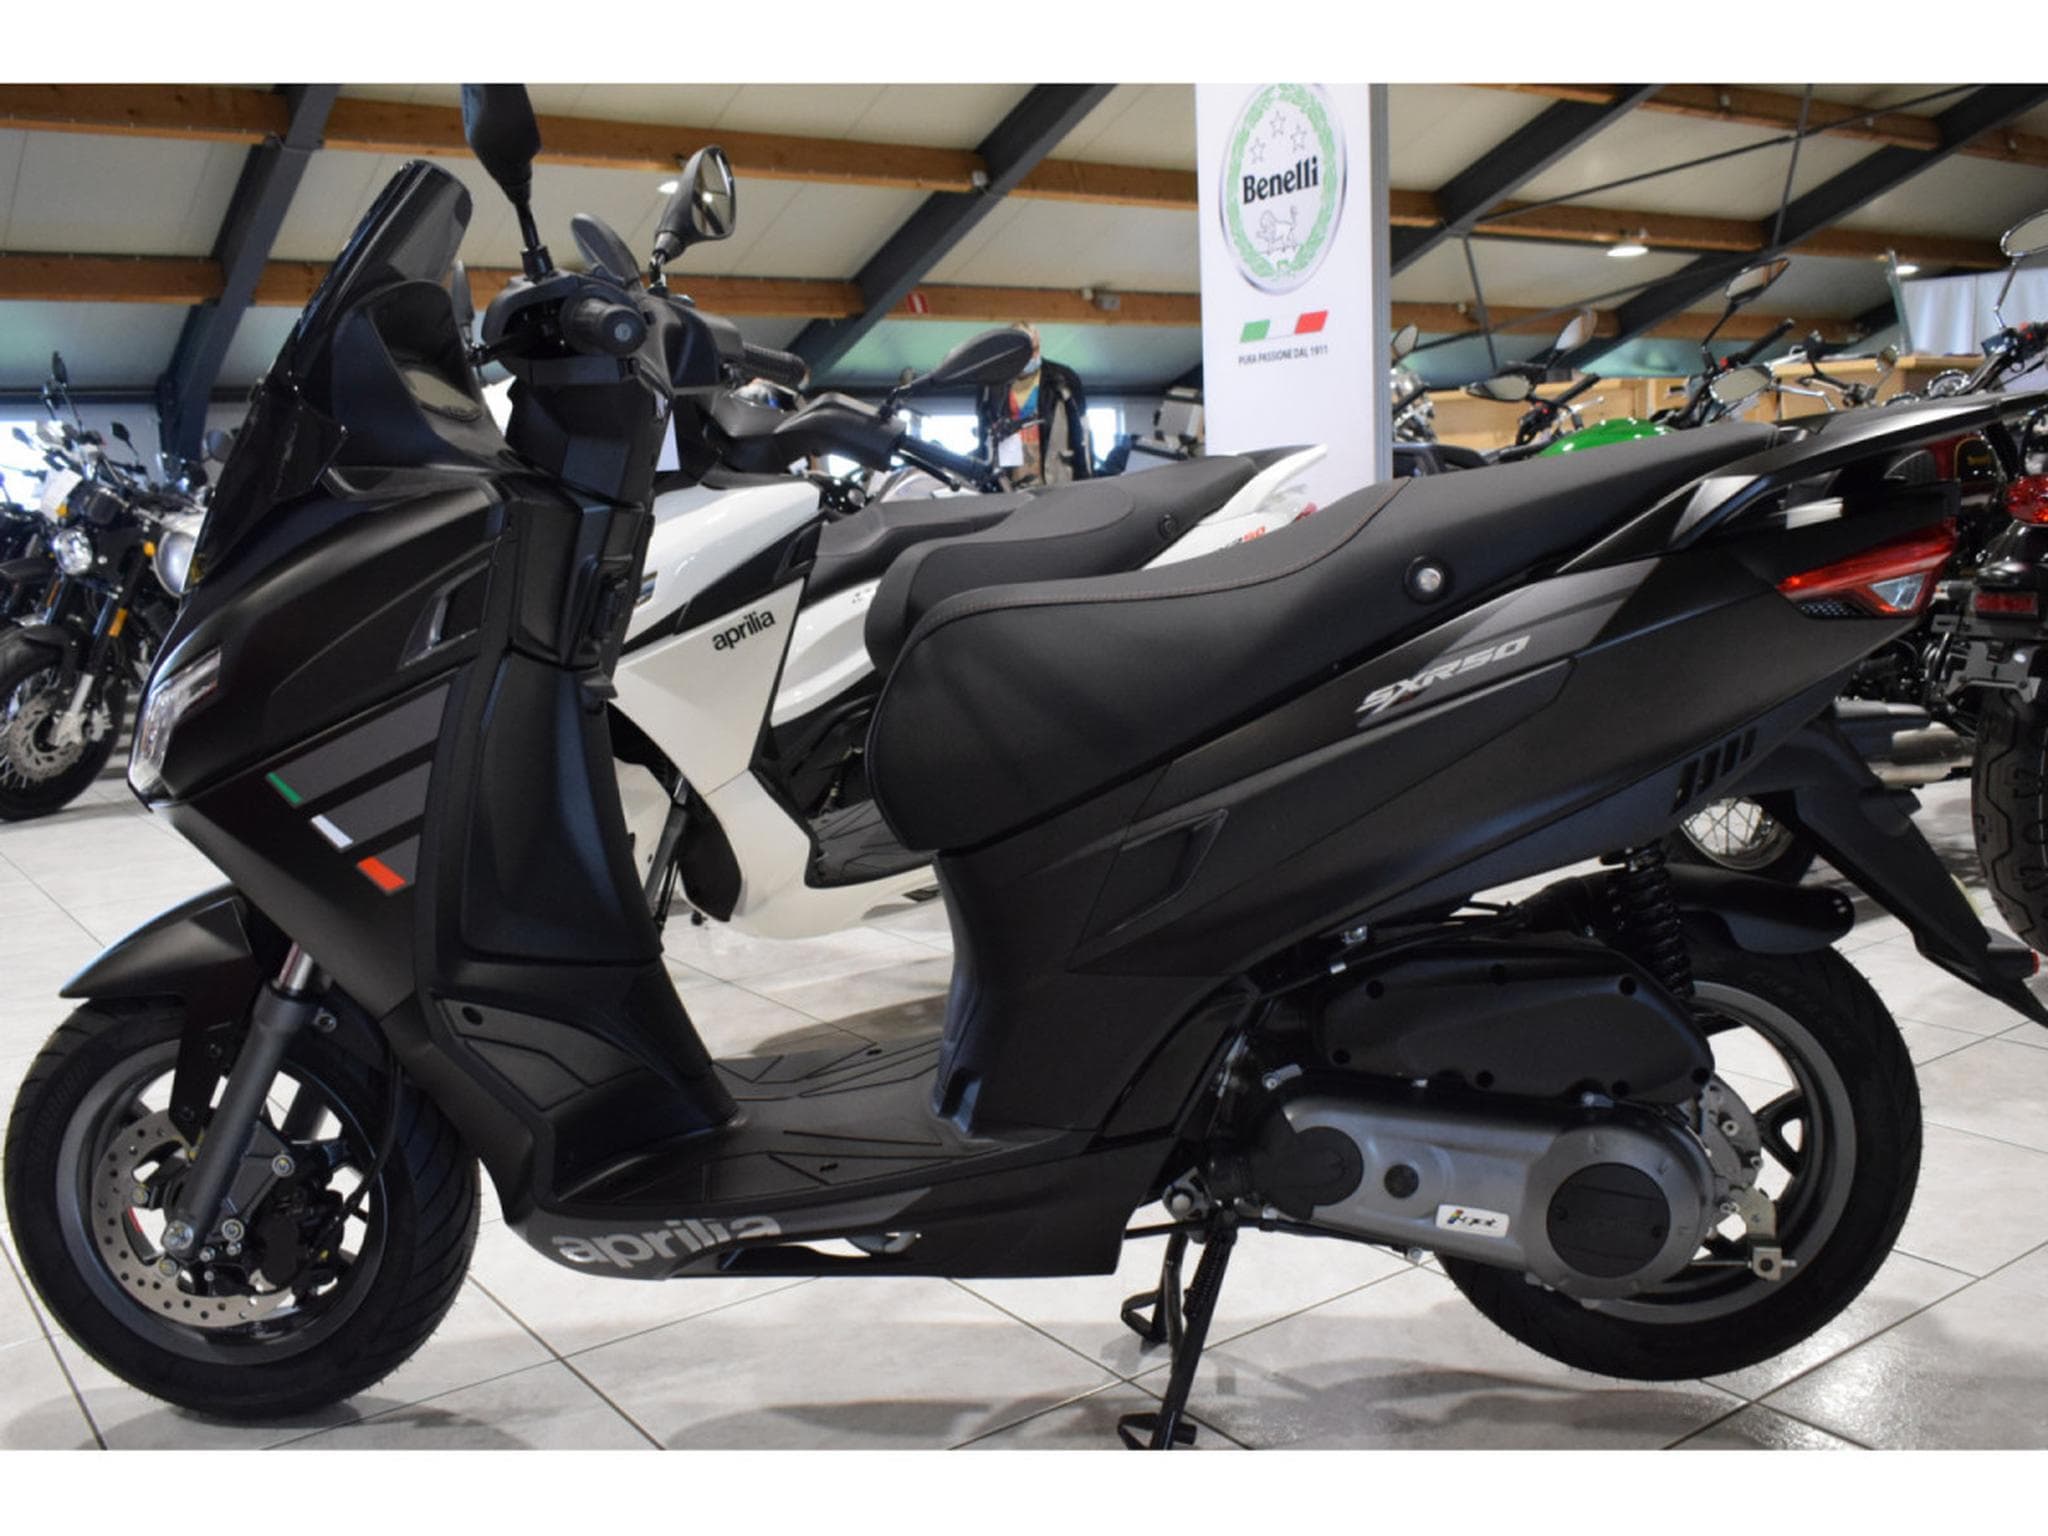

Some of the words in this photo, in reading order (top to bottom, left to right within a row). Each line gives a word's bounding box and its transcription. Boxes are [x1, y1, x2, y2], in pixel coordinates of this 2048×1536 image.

[1243, 155, 1318, 204] Benelli
[1310, 344, 1328, 356] 1911
[712, 610, 776, 651] aprilia
[1355, 635, 1531, 715] SXR50
[552, 1215, 782, 1269] aprilia
